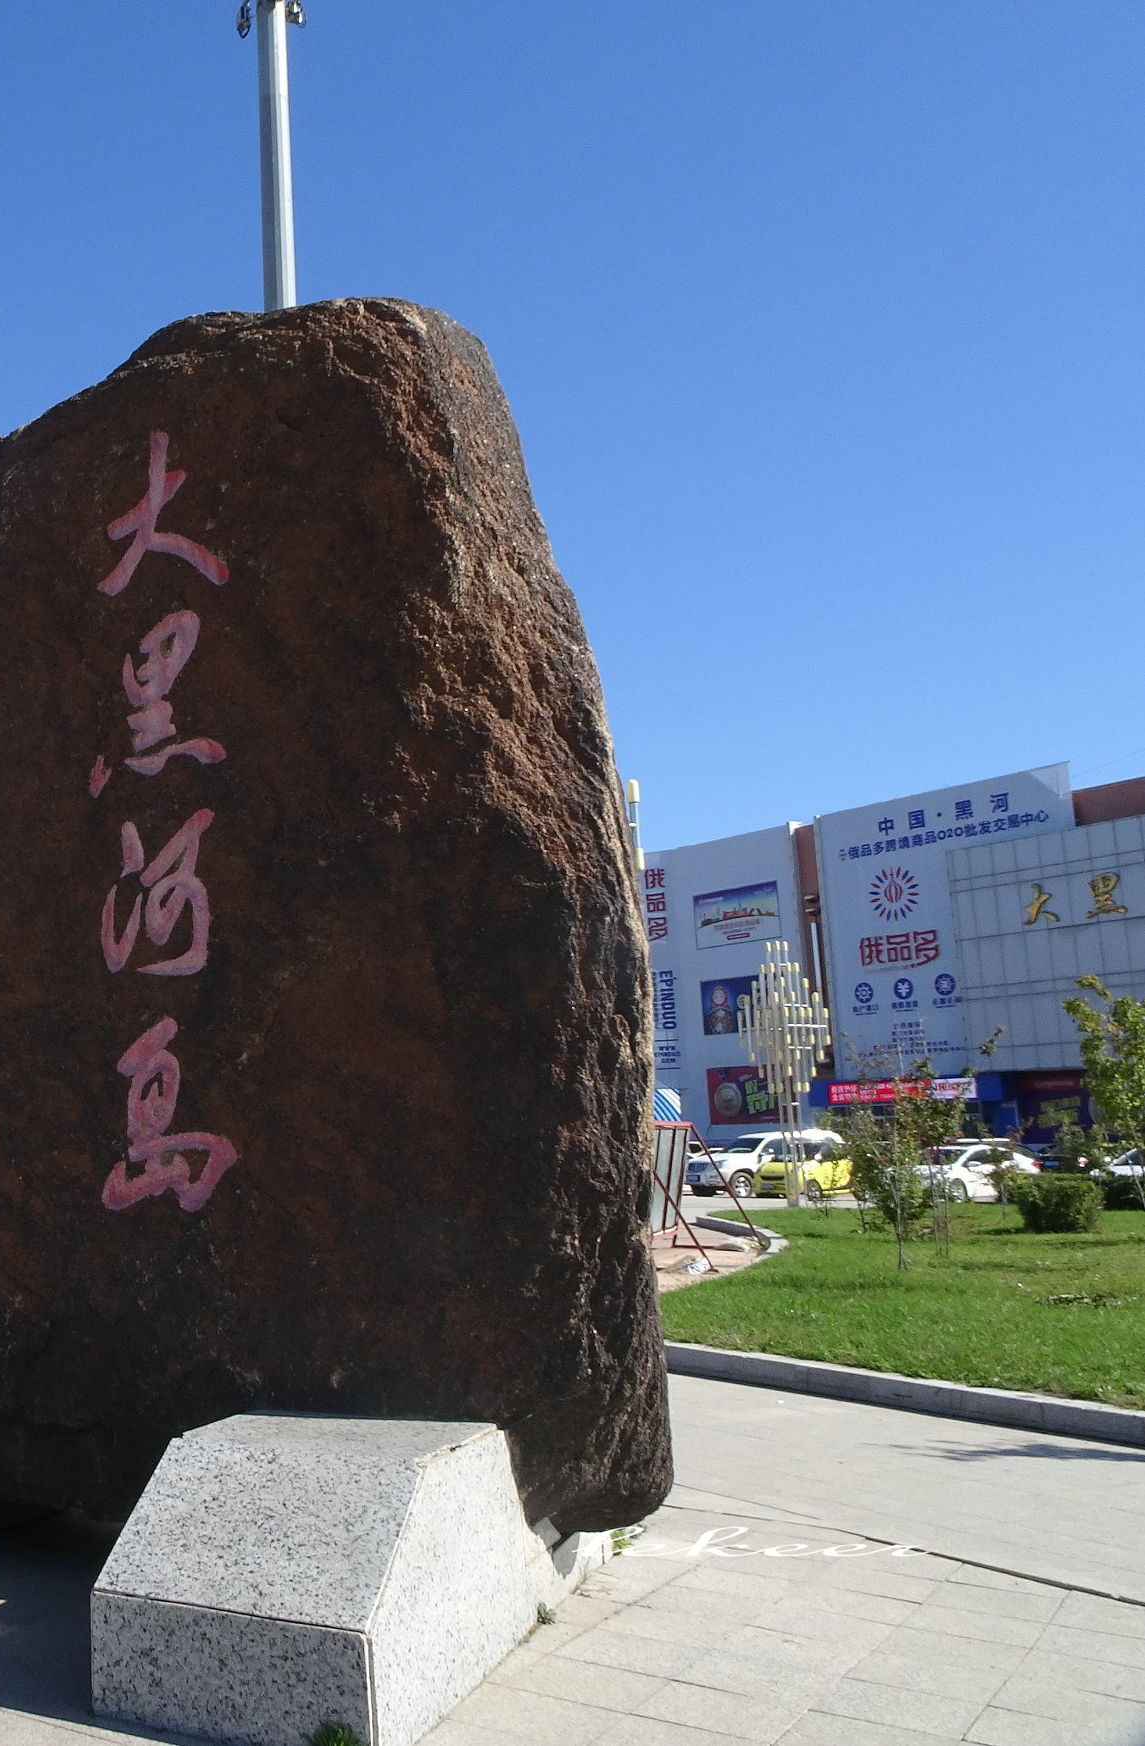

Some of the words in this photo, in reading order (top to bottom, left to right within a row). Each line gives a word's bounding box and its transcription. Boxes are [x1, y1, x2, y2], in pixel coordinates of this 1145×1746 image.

[644, 868, 668, 941] 俄品多
[859, 929, 940, 969] 俄品多
